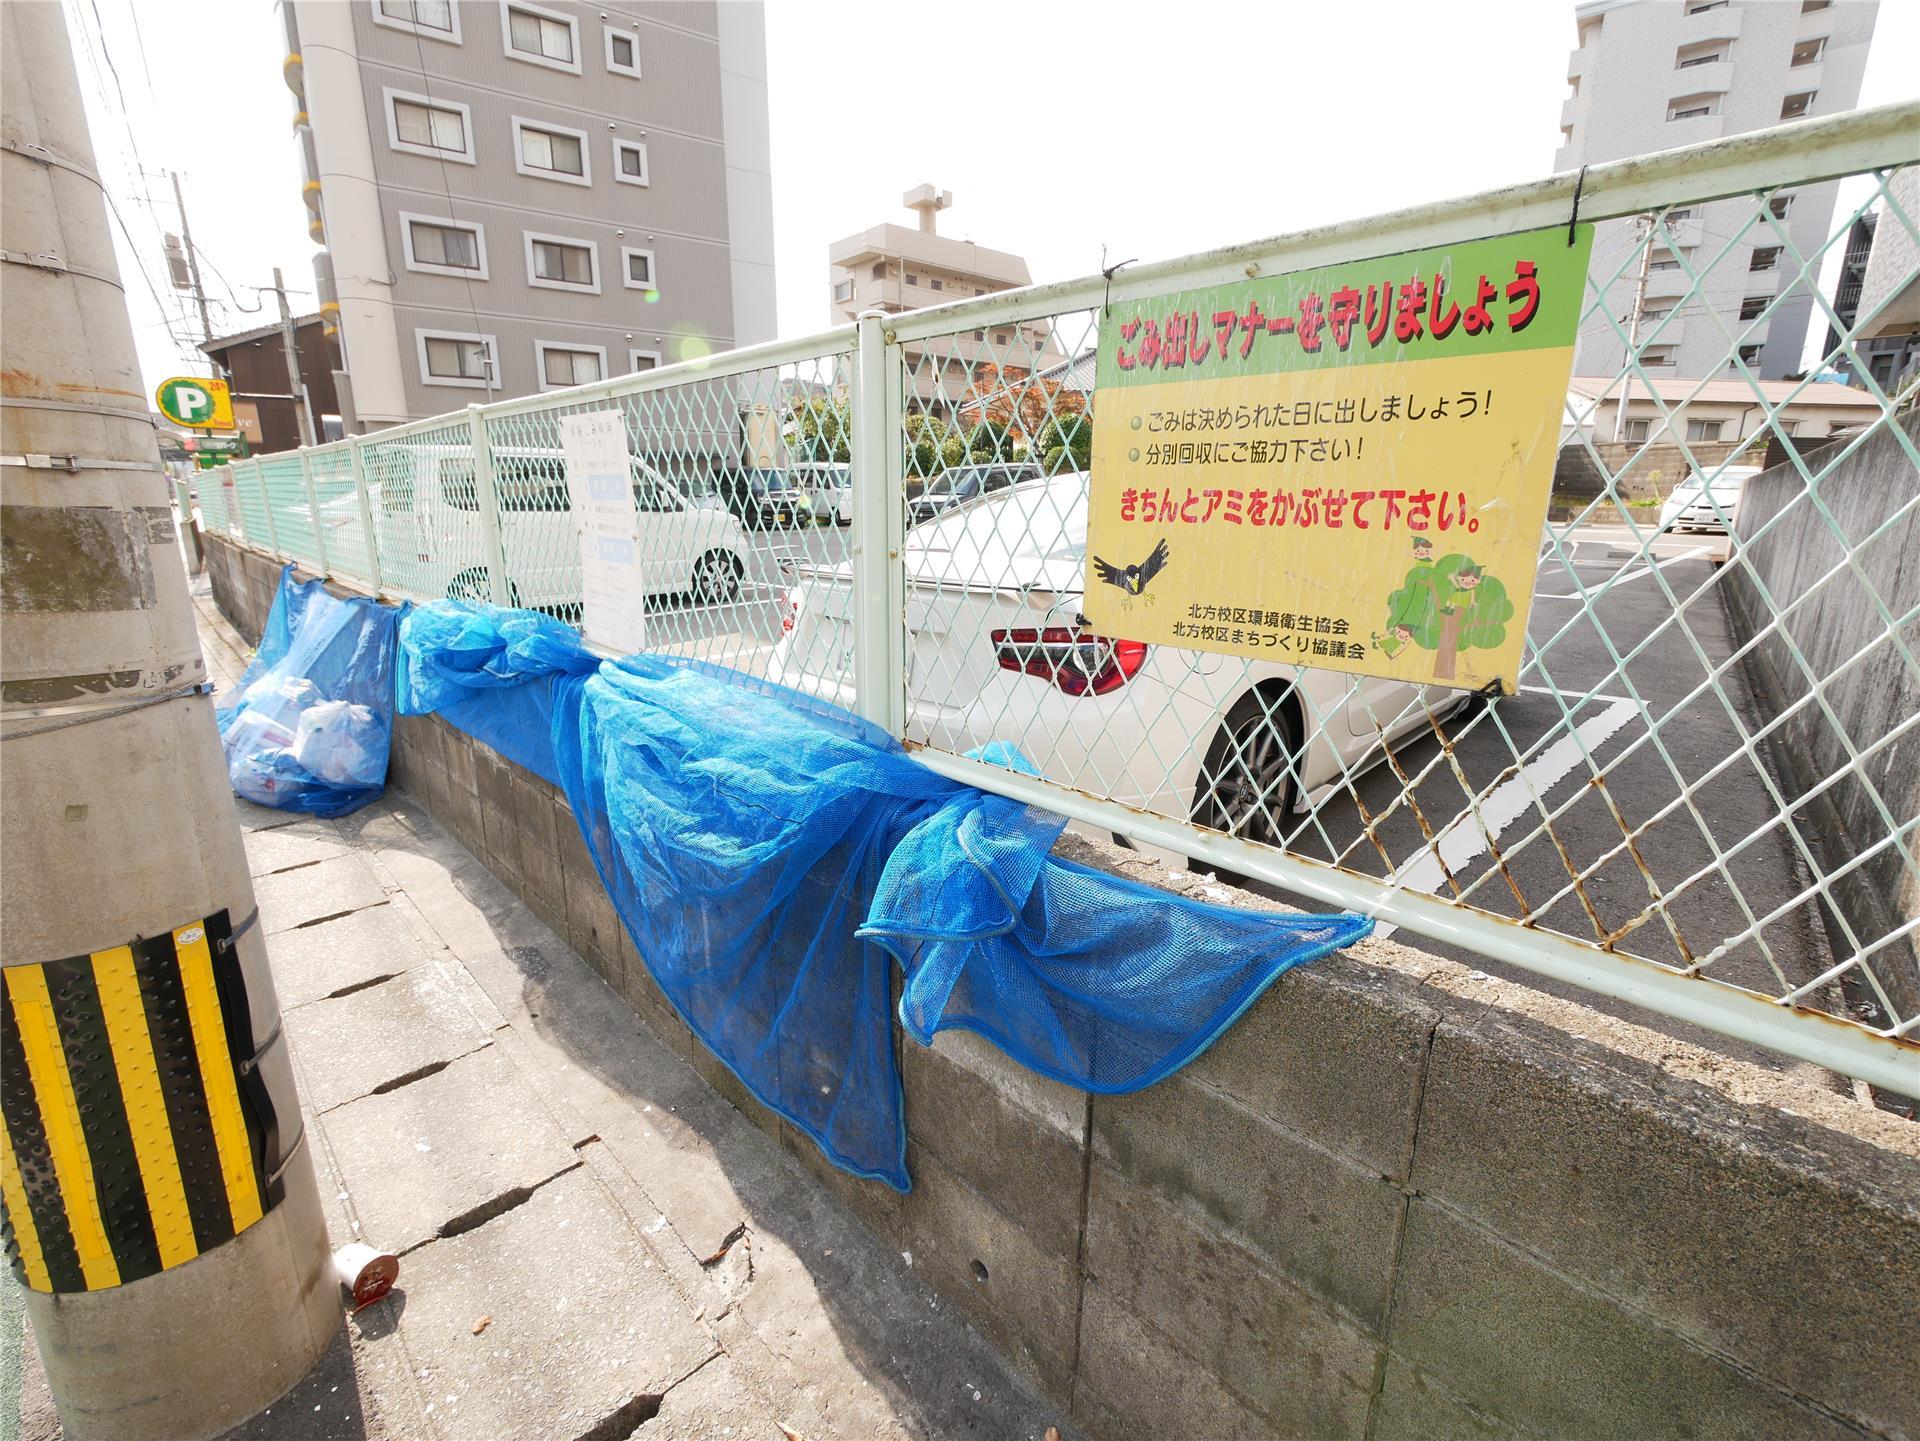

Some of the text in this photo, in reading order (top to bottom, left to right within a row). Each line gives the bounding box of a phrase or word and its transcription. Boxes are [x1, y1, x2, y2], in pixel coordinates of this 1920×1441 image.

[1117, 261, 1540, 370] ごみ出しマナーを守りましょう
[175, 387, 207, 419] P
[1120, 487, 1479, 534] きちんとアミをかぶせて下さい。
[1188, 603, 1350, 636] 北方校区環境衛生協会
[1172, 621, 1366, 660] 北方校区まちづくり協議会
